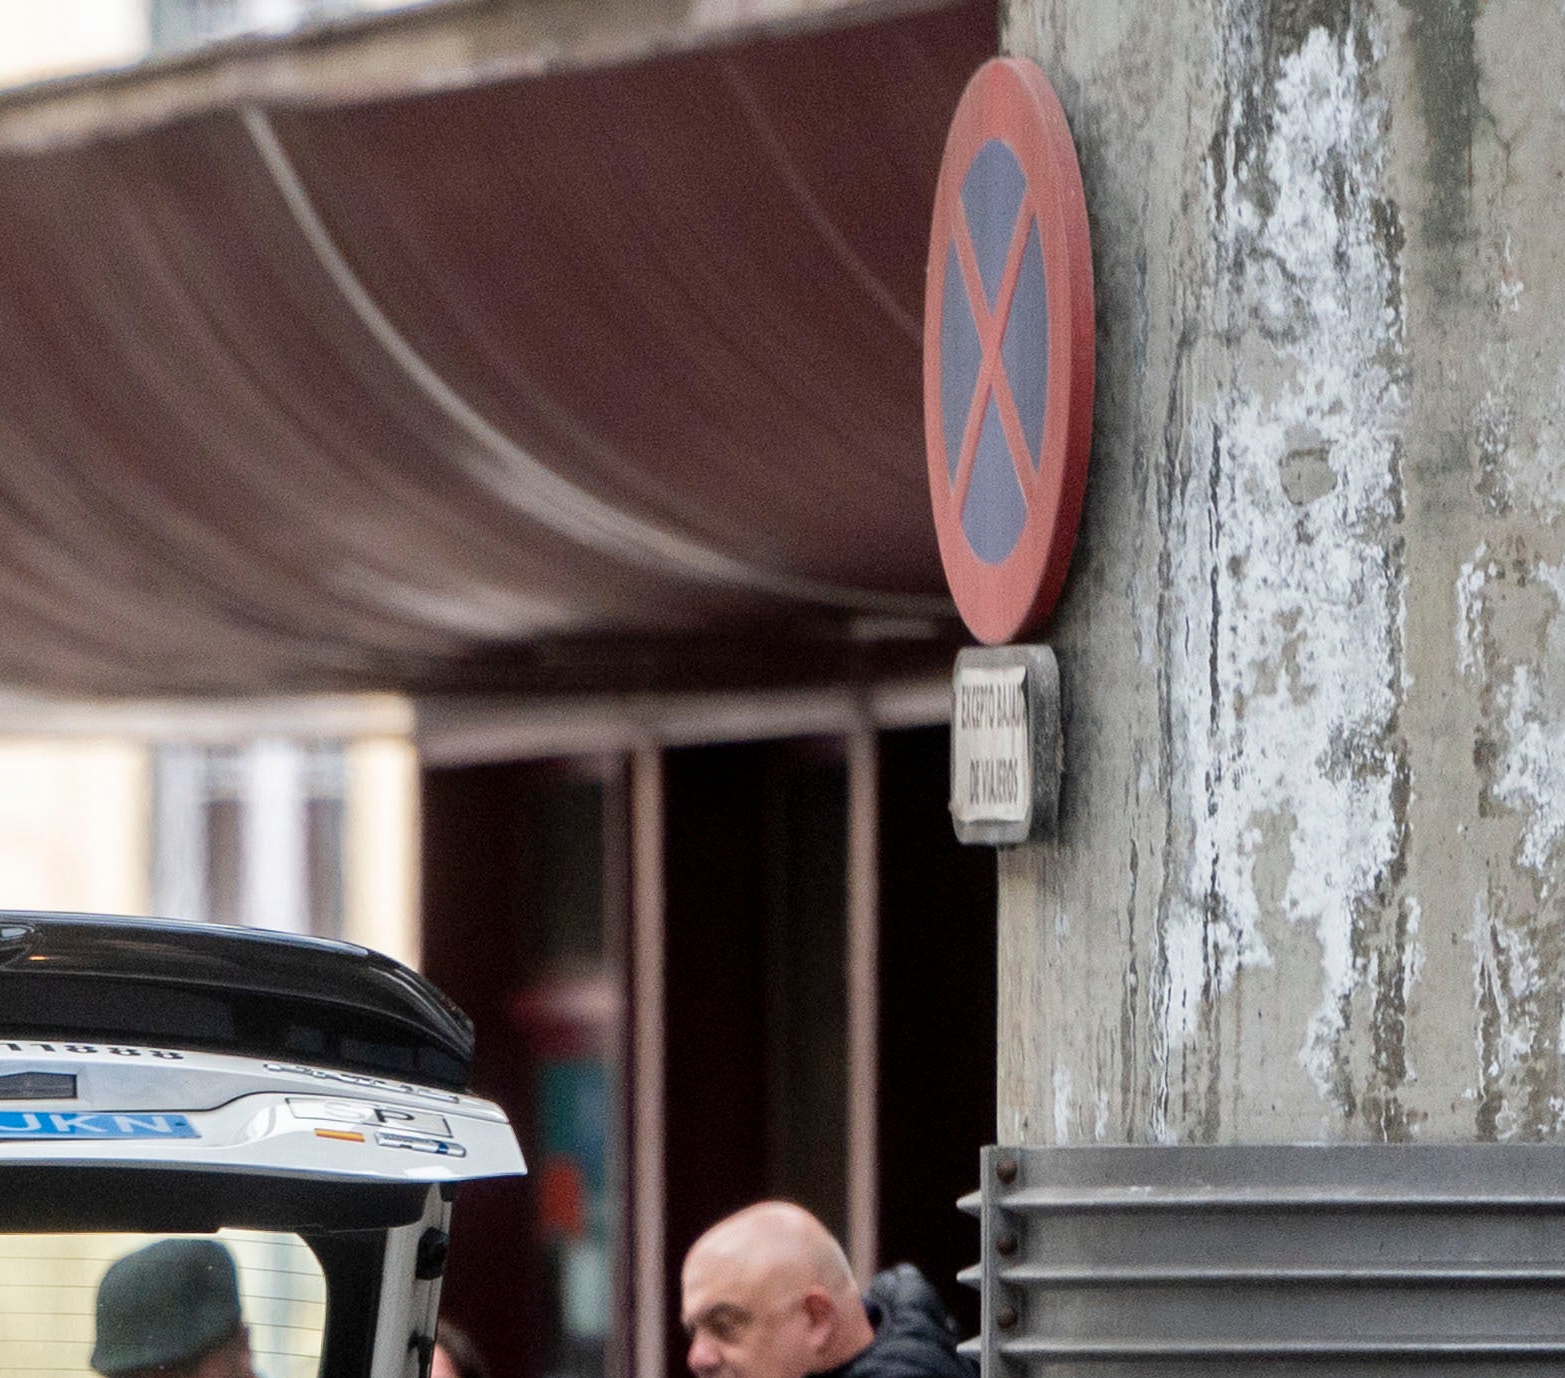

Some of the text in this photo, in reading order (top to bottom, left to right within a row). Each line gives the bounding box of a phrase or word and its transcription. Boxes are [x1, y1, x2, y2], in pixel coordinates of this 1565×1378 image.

[996, 681, 1026, 730] BAJAD
[968, 756, 1019, 806] DE VIAJEROS
